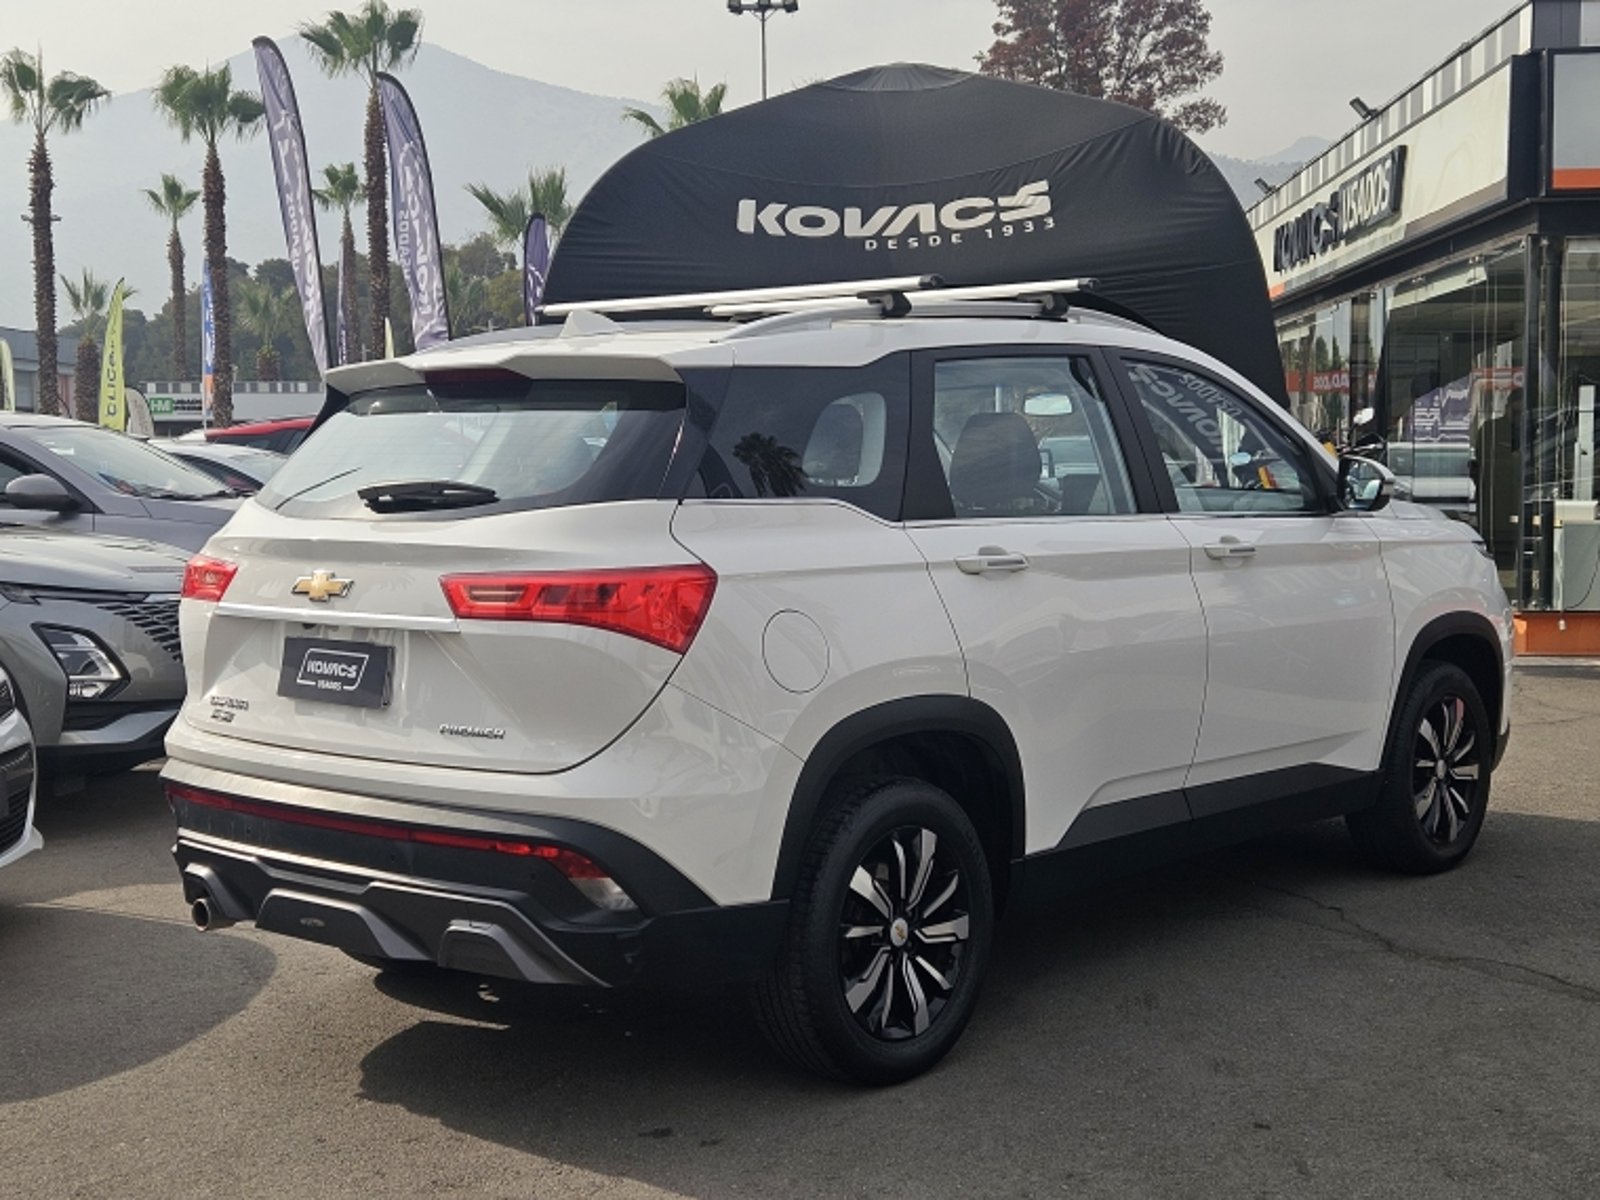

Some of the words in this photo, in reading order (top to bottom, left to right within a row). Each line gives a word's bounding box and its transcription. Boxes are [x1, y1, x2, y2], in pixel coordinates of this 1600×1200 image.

[736, 179, 1052, 237] KOVACS
[1342, 159, 1393, 234] USADOS
[865, 233, 962, 251] DESDE
[985, 216, 1056, 239] 1933
[306, 660, 358, 679] KOVACS
